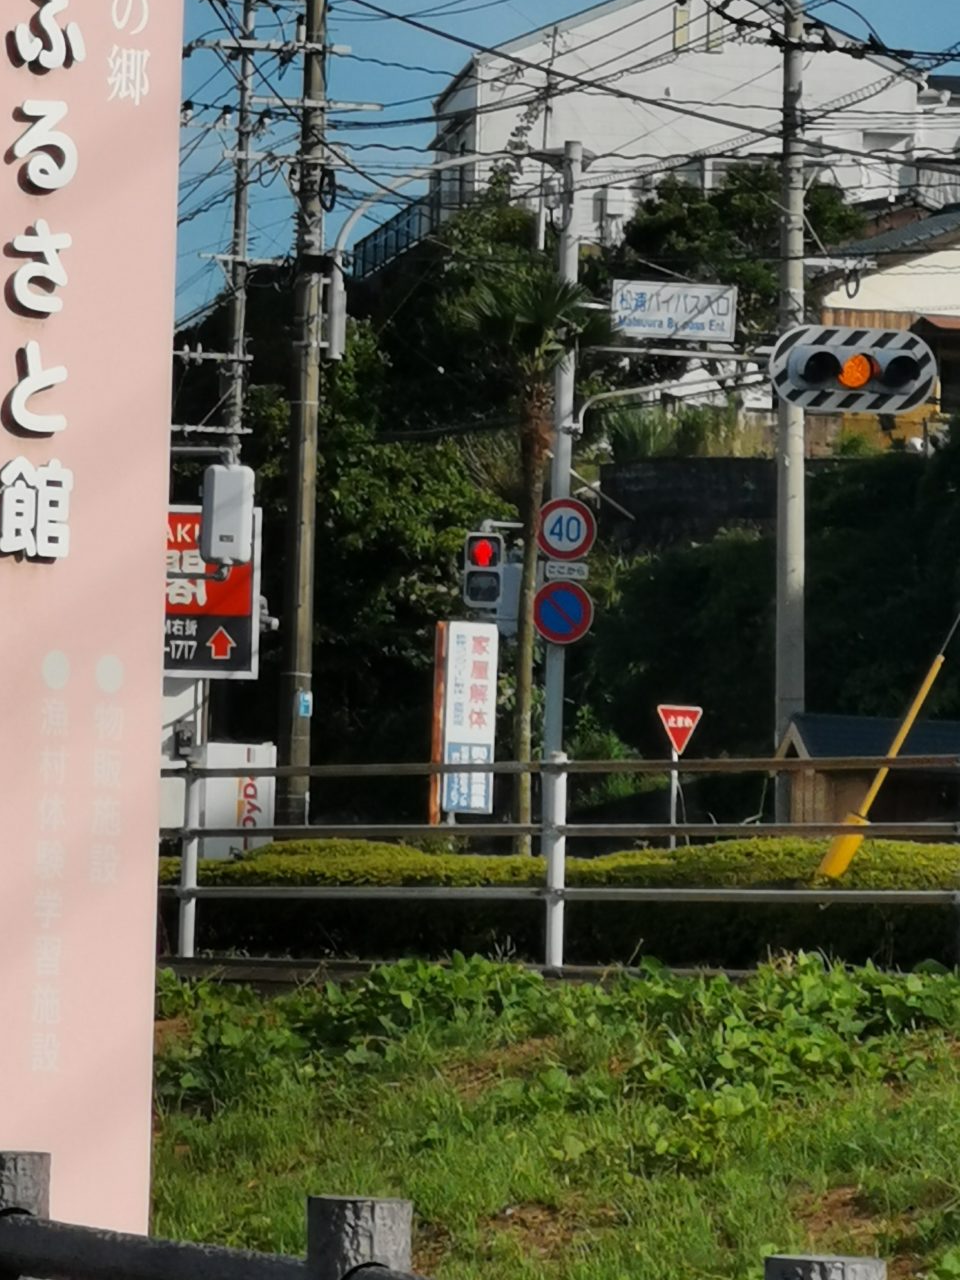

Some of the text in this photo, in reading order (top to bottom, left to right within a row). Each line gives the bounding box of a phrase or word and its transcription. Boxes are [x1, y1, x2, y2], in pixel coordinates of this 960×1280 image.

[619, 289, 730, 317] 松浦バイパス入口
[549, 515, 581, 542] 40
[548, 564, 585, 577] ここから
[468, 634, 491, 730] 家屋解体
[667, 715, 693, 728] 止まれ
